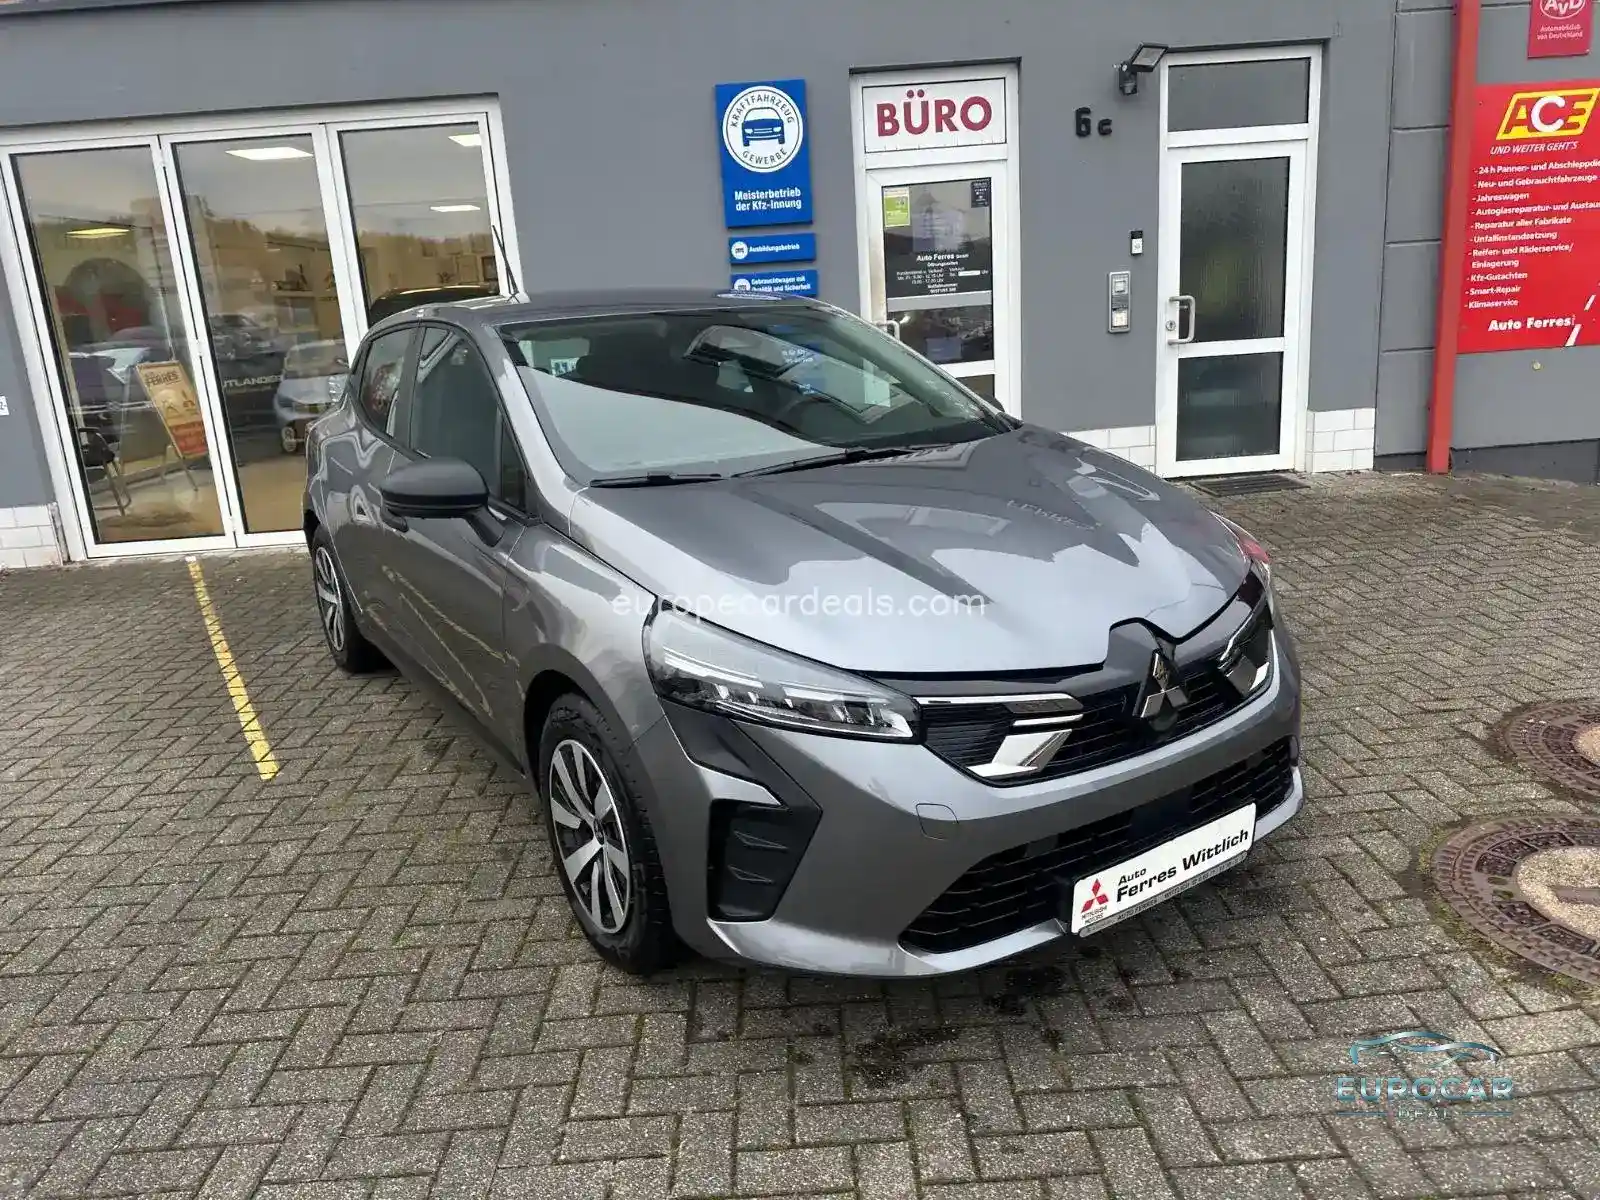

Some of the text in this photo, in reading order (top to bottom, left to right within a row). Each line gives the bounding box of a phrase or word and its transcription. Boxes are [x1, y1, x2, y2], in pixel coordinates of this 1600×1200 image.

[1537, 31, 1583, 40] von Deutschland
[730, 94, 795, 127] KRAFTFAHRZEUG
[876, 89, 992, 137] BÜRO
[1499, 90, 1598, 138] ACE
[1490, 141, 1578, 154] UND WEITER GEHT'S
[742, 147, 788, 165] GEWERBE
[1478, 166, 1488, 174] 24
[1497, 164, 1529, 173] Pannen-
[1531, 162, 1547, 170] und
[1477, 174, 1597, 188] Neu- und Gebrauchtfahrzeuge
[734, 187, 801, 201] Meisterbetrieb
[1476, 192, 1529, 202] Jahreswagen
[736, 198, 802, 211] der Kfz-Innung
[1475, 205, 1552, 217] Autoglasreparatur-
[1553, 203, 1568, 211] und
[1475, 216, 1572, 231] Reparatur aller Fabrikate
[1474, 231, 1557, 243] Unfallinstandsetzung
[749, 242, 800, 253] Ausbildungsbetrieb
[1472, 247, 1500, 256] Reifen-
[1502, 246, 1518, 255] und
[916, 254, 933, 262] Auto
[934, 253, 955, 261] Ferres
[1471, 259, 1519, 269] Einlagerung
[751, 277, 795, 286] Gebrauchtwagen
[1470, 271, 1528, 282] Kfz-Gutachten
[1469, 285, 1521, 296] Smart-Repair
[1468, 298, 1519, 309] Klimaservice
[1488, 319, 1521, 332] Auto
[1526, 316, 1571, 329] Ferres
[1116, 866, 1177, 903] Ferres
[1183, 829, 1249, 871] Wittlich
[1118, 867, 1147, 886] Auto
